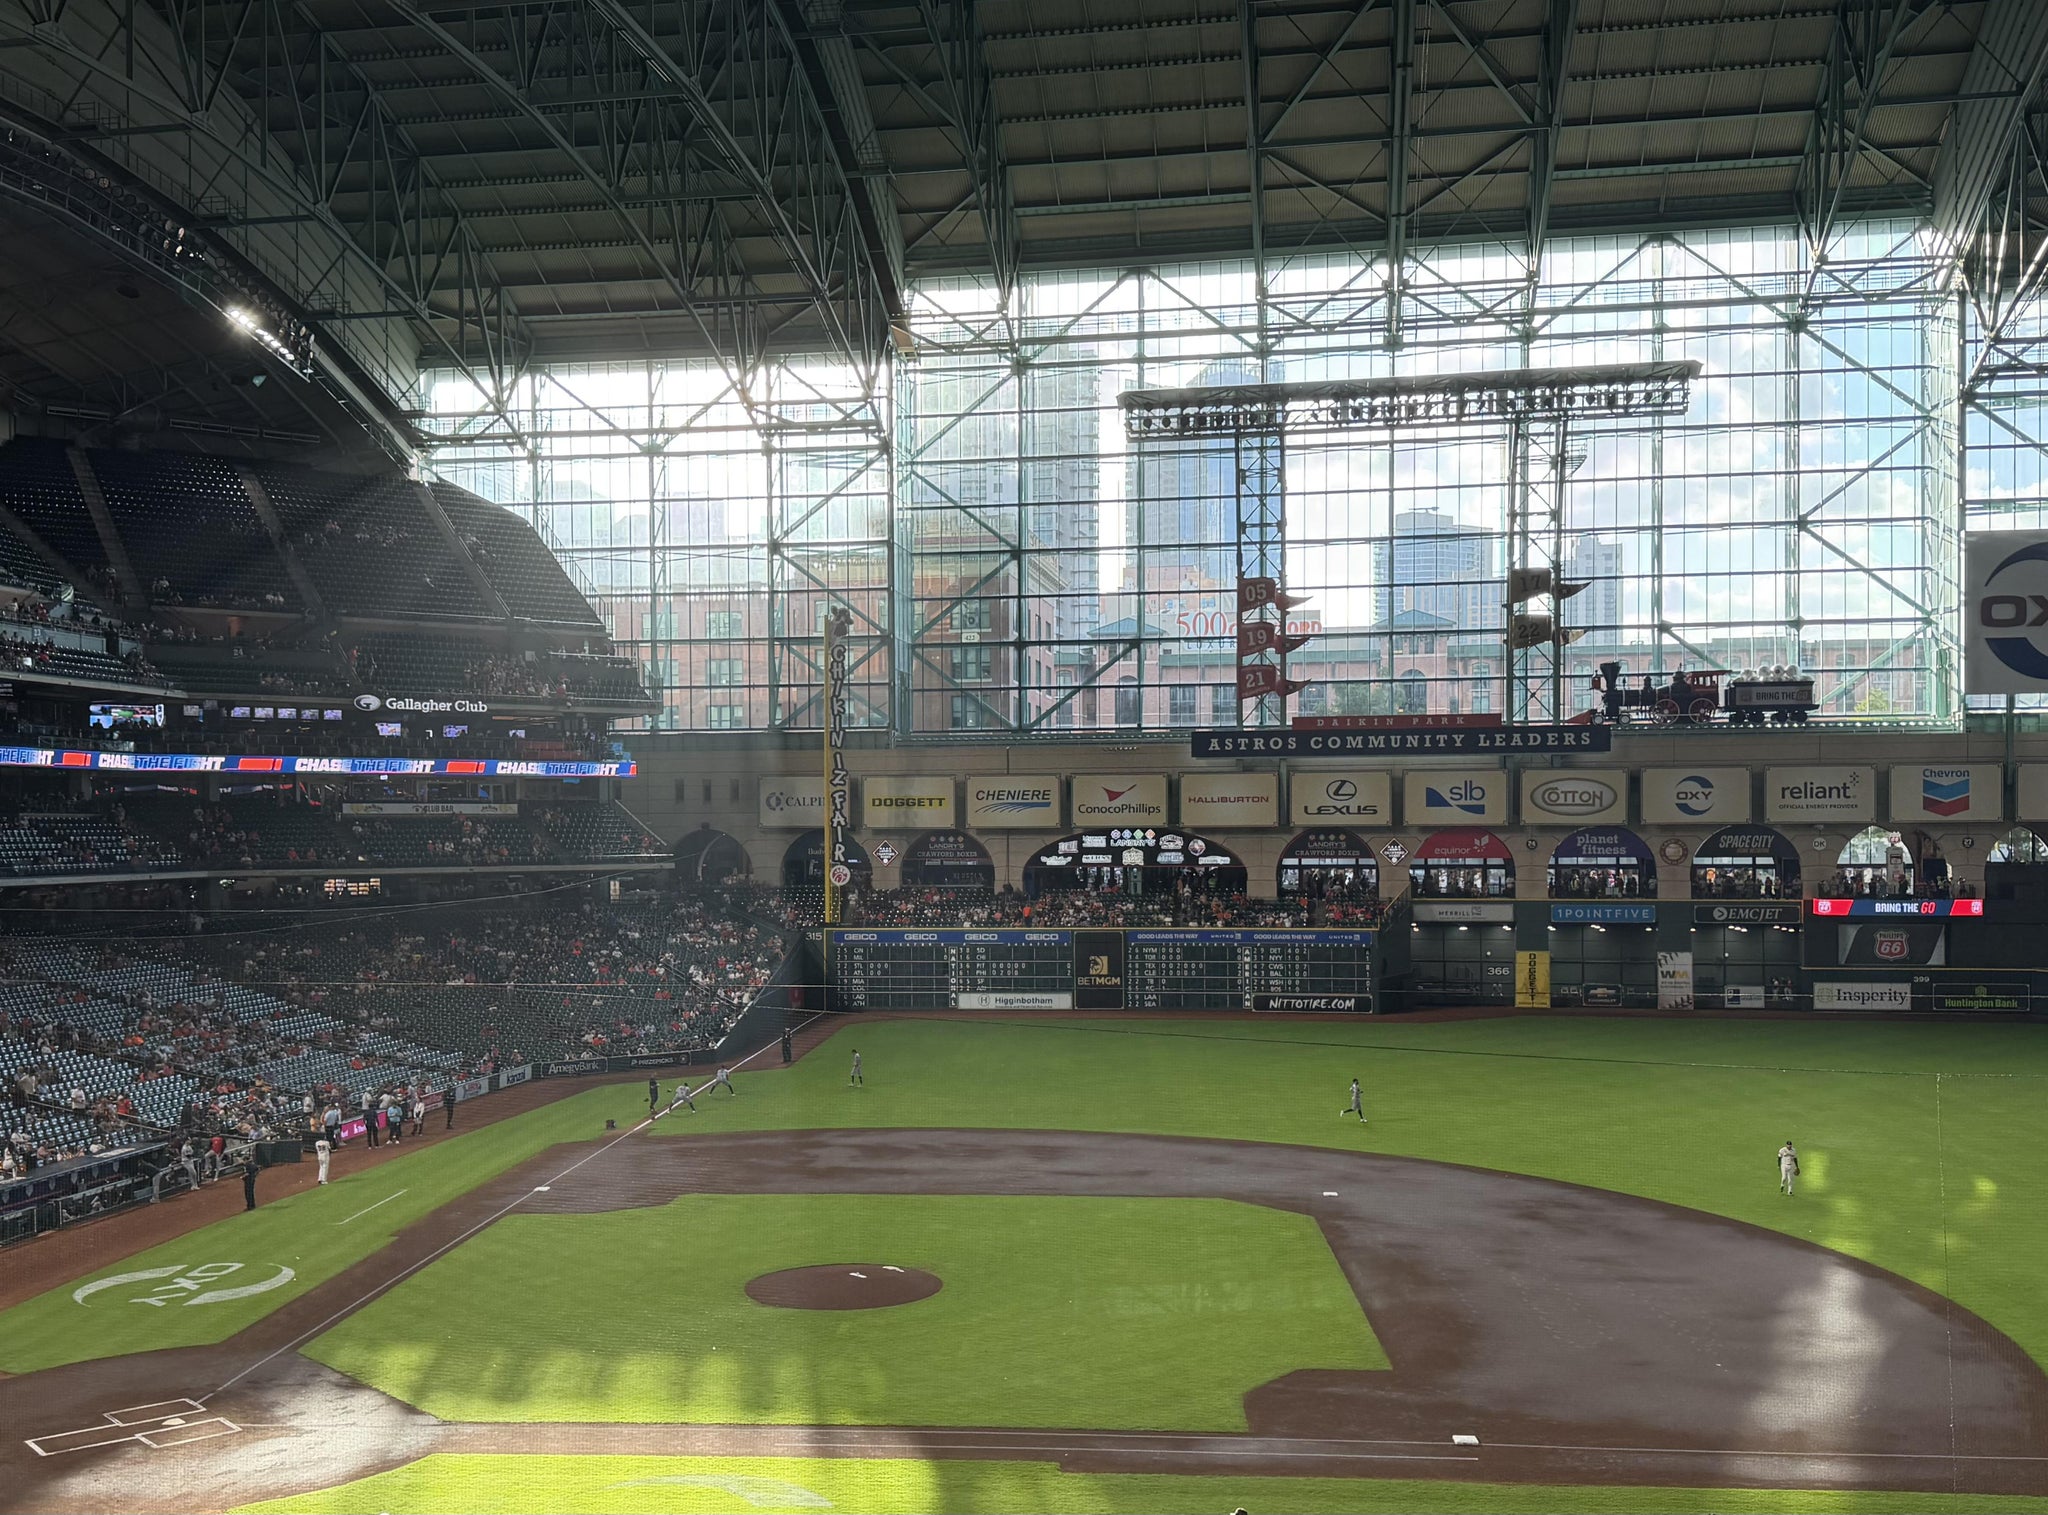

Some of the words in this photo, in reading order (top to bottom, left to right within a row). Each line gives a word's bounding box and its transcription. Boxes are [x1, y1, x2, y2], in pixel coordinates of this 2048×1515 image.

[1245, 584, 1267, 602] 05
[1176, 611, 1228, 636] 500
[1519, 623, 1540, 638] 22
[1247, 630, 1267, 646] 19
[1246, 672, 1265, 688] 21
[1756, 691, 1780, 701] BRING
[1781, 691, 1796, 701] THE
[386, 698, 452, 713] Gallagher
[455, 700, 488, 713] Club
[1316, 718, 1394, 728] DAIKIN
[1412, 716, 1465, 726] PARK
[1208, 737, 1298, 752] ASTROS
[1310, 734, 1464, 750] COMMUNITY
[1478, 732, 1591, 748] LEADERS
[0, 749, 18, 764] HE
[19, 750, 54, 766] FIGHT
[98, 754, 135, 769] CHASE
[136, 756, 171, 769] THE
[171, 757, 225, 770] FIGHT
[295, 758, 352, 772] CHASE
[354, 760, 388, 772] THE
[388, 760, 434, 773] FIGHT
[496, 762, 547, 774] CHASE
[549, 763, 578, 774] THE
[578, 763, 619, 776] FIGHT
[1922, 768, 1970, 778] Chevron
[976, 790, 1051, 800] CHENIERE
[1450, 780, 1485, 801] slb
[1676, 792, 1712, 800] OXY
[1781, 782, 1850, 800] reliant
[786, 798, 824, 806] CALPI
[872, 798, 945, 807] DOGGETT
[1188, 796, 1268, 804] HALLIBURTON
[1078, 804, 1160, 815] ConocoPhillips
[1304, 805, 1378, 815] LEXUS
[831, 791, 846, 863] FAIR
[1110, 838, 1156, 847] LANDRY'S
[1308, 840, 1346, 848] LANDRY'S
[1576, 834, 1618, 846] planet
[1719, 835, 1750, 848] SPACE
[1751, 835, 1774, 848] CITY
[1434, 846, 1470, 856] equinor
[1582, 846, 1626, 855] fitness
[1558, 908, 1649, 918] 1POINTFIVE
[1875, 902, 1902, 913] BRING
[1902, 902, 1919, 912] THE
[1920, 902, 1936, 914] GO
[1728, 908, 1782, 922] EMCJET
[806, 932, 822, 941] 315
[1879, 932, 1904, 940] PHILLIPS
[1880, 942, 1902, 954] 66
[1487, 967, 1510, 976] 366
[1528, 953, 1536, 1001] DOGGETT
[1660, 970, 1689, 979] WM
[1078, 976, 1120, 986] BETMGM
[994, 996, 1053, 1006] Higginbotham
[1837, 988, 1908, 1004] Insperity
[1269, 996, 1356, 1010] NITTOTIRE.COM
[1945, 998, 1994, 1010] Huntington
[1995, 998, 2018, 1008] Bank
[549, 1062, 599, 1076] AmegyBank
[129, 1262, 246, 1307] OXY
